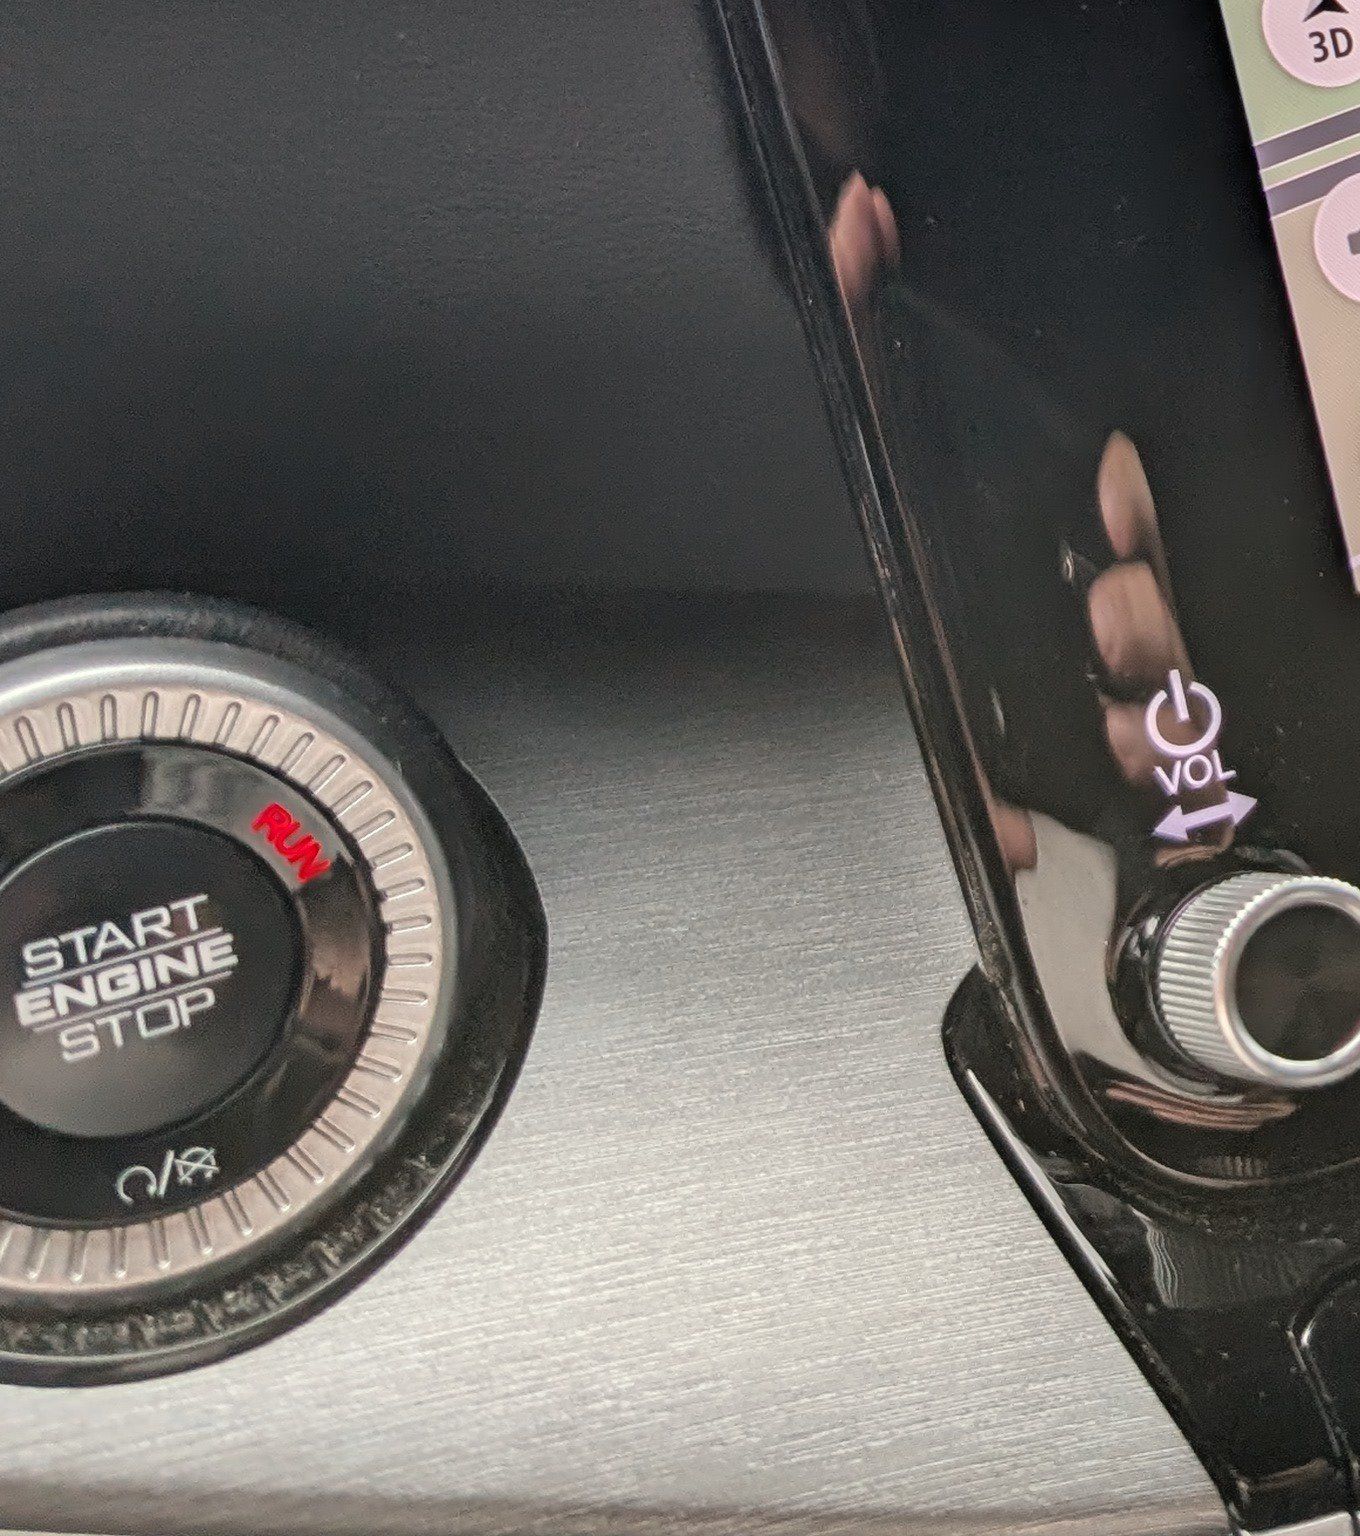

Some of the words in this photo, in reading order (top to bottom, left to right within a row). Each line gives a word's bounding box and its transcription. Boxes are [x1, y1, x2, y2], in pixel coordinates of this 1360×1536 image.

[1308, 27, 1354, 63] 3D
[1153, 749, 1237, 796] VOL
[251, 802, 331, 883] RUN
[22, 894, 209, 978] START
[14, 933, 239, 1027] ENGINE
[57, 988, 216, 1062] STOP
